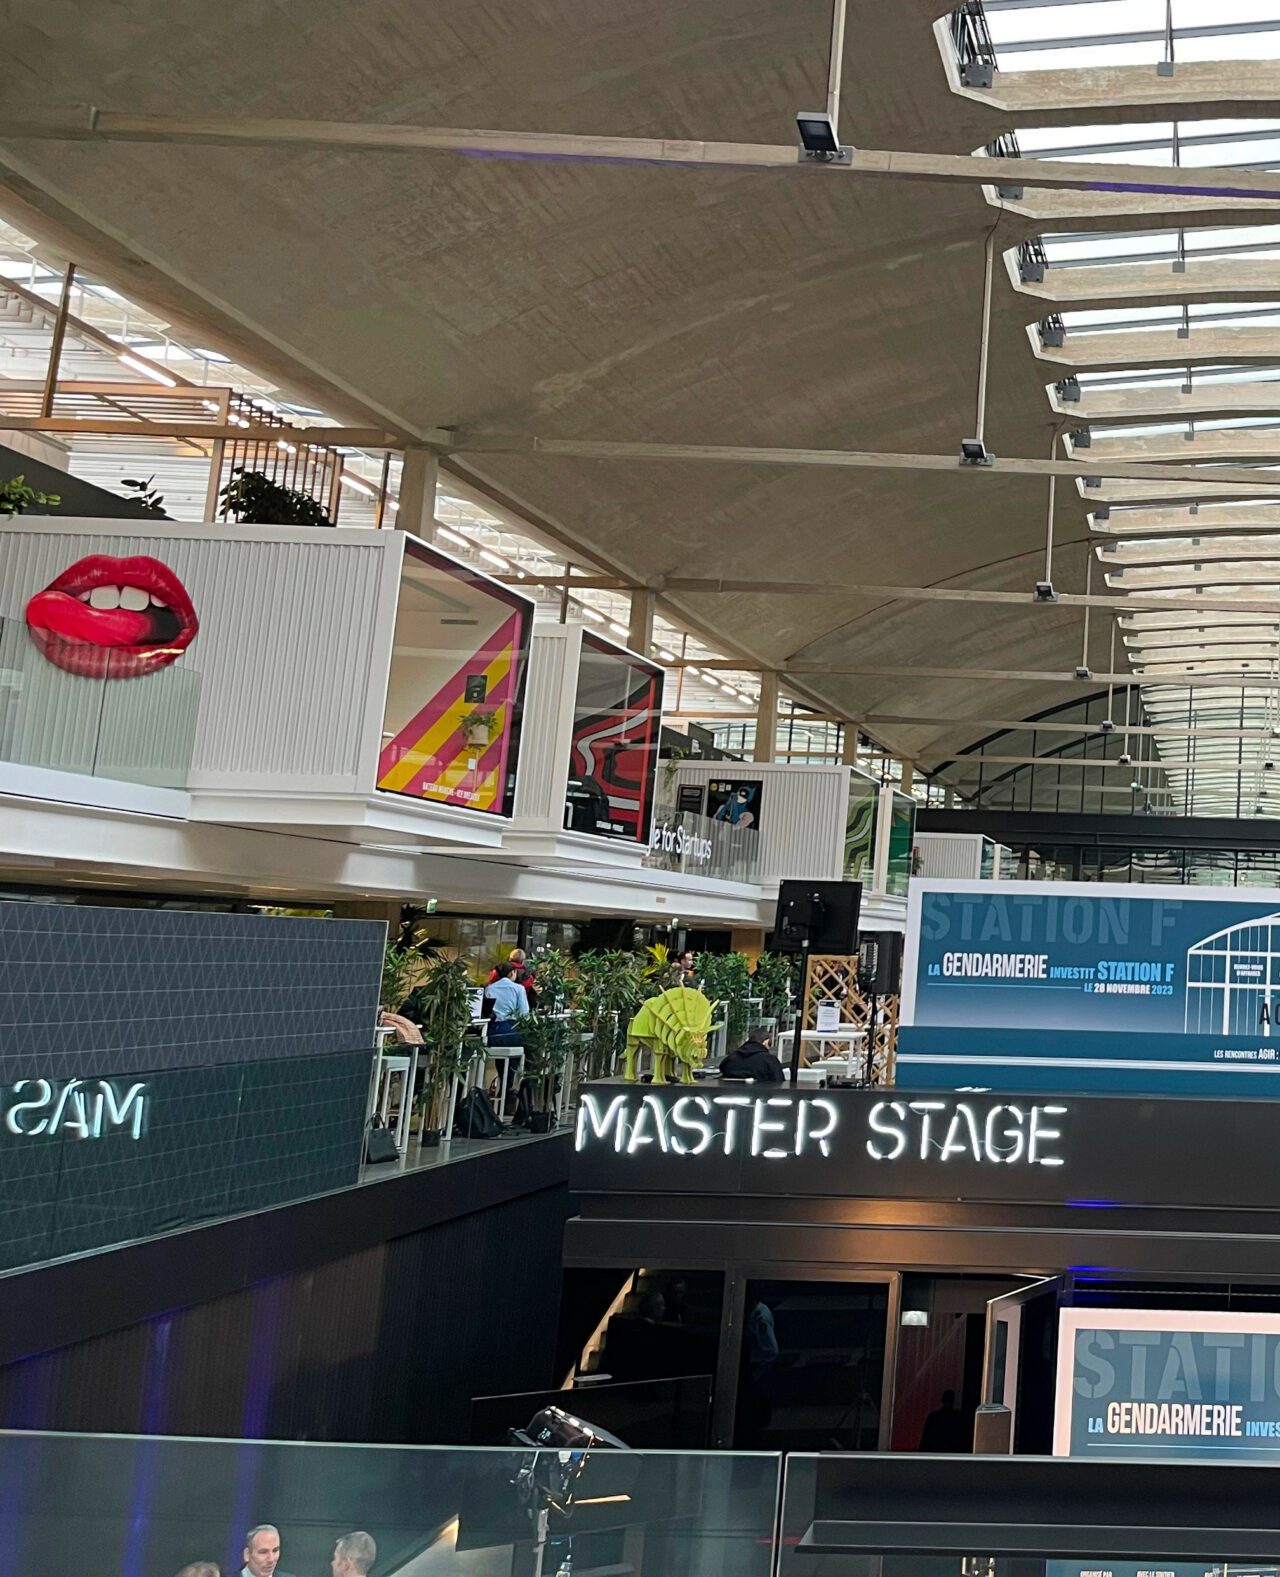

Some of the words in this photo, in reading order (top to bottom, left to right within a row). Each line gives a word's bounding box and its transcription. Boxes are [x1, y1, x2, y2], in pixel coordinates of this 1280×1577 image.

[662, 822, 676, 852] for
[676, 825, 712, 865] Startups
[921, 893, 1130, 945] STATION
[1152, 899, 1183, 946] F
[928, 964, 940, 976] LA
[943, 952, 1048, 979] GENDARMERIE
[1050, 966, 1095, 980] INVESTIT
[1098, 961, 1161, 982] STATION
[1165, 963, 1174, 982] F
[1084, 983, 1093, 993] LE
[1094, 983, 1105, 993] 28
[1106, 984, 1150, 995] NOVEMBRE
[1151, 985, 1174, 995] 2023
[1214, 1049, 1223, 1058] LES
[1225, 1050, 1257, 1059] RENCONTRES
[1258, 1048, 1275, 1060] AGIR
[575, 1094, 837, 1158] MASTER
[866, 1101, 1067, 1166] STAGE
[1088, 1417, 1104, 1434] LA
[1107, 1402, 1243, 1437] GENDARMERIE
